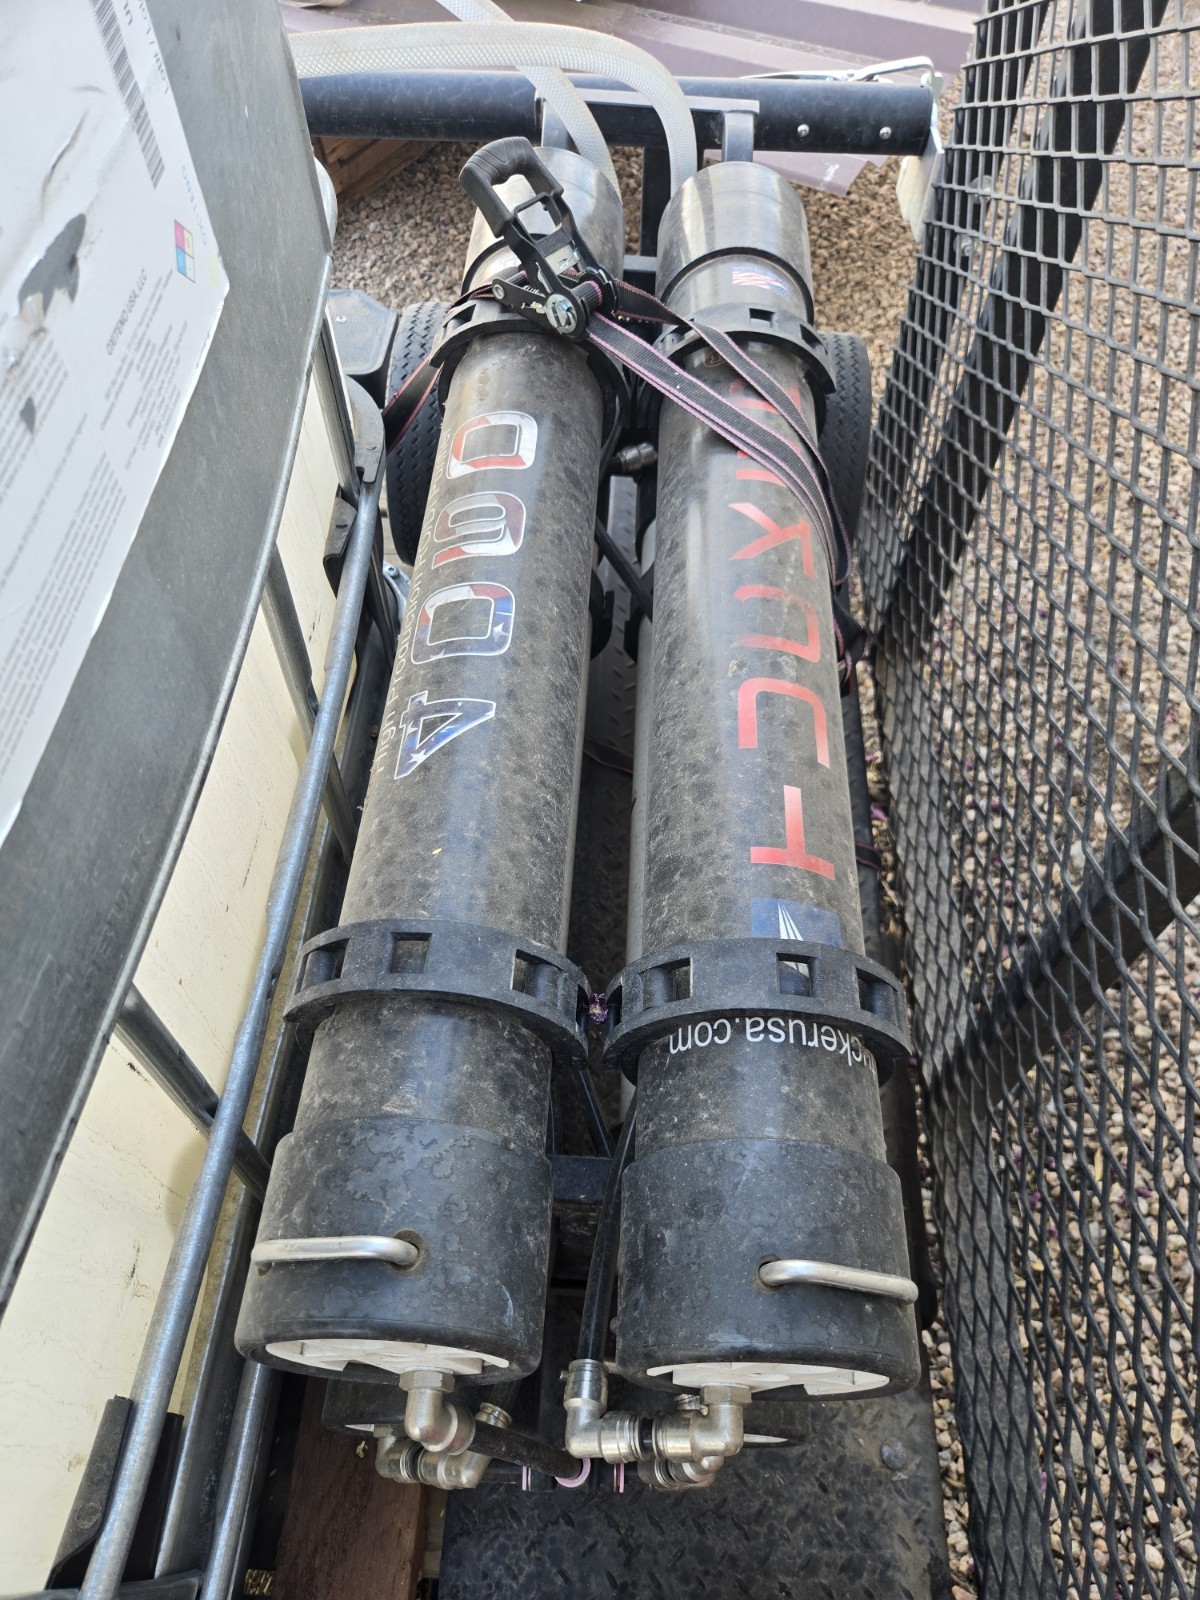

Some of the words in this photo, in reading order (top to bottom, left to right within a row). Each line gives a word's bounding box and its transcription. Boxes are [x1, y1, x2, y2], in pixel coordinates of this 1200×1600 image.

[181, 165, 208, 246] OXITENO
[105, 309, 129, 356] OXITENO
[394, 411, 538, 780] 4060
[373, 710, 396, 774] High
[386, 574, 422, 706] Production
